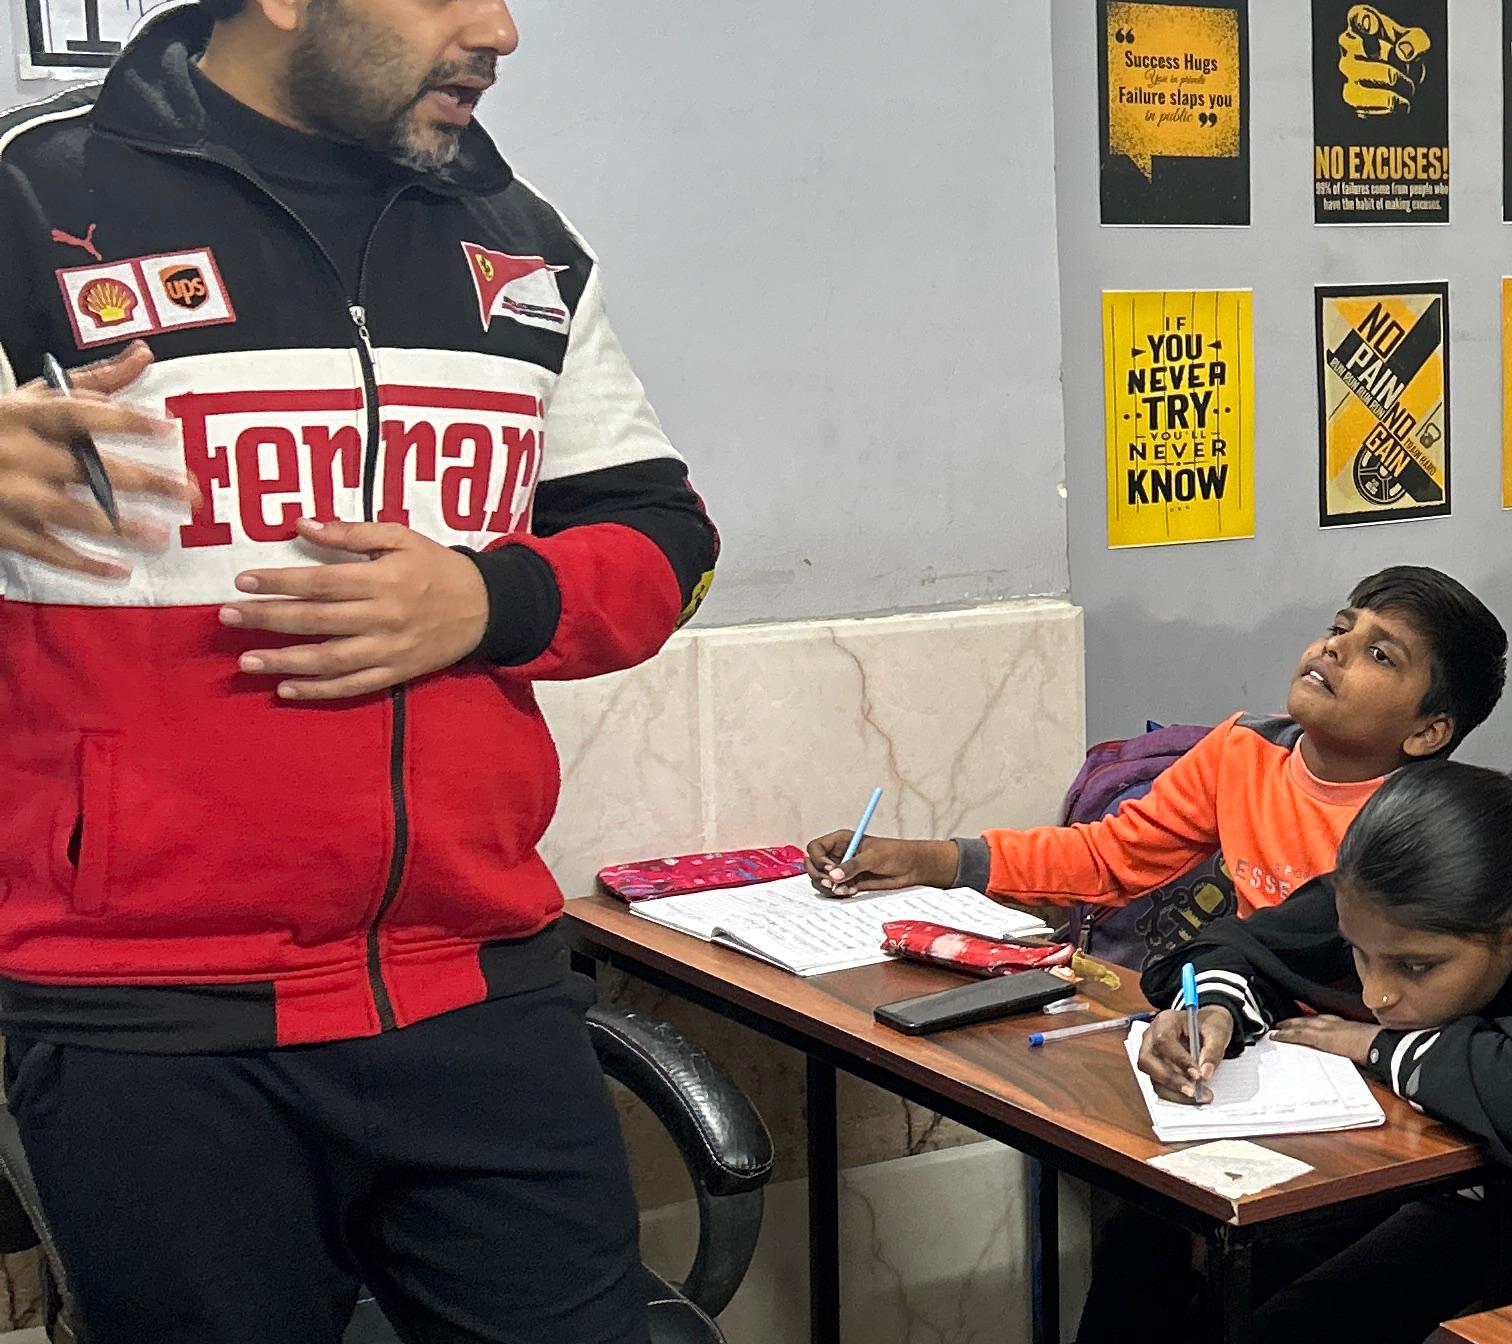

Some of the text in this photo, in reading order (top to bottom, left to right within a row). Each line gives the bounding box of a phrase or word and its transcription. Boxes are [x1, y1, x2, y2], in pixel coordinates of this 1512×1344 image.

[1125, 50, 1218, 72] Success Hugs
[1119, 86, 1232, 109] Failure slaps you
[1145, 108, 1193, 127] in public
[1315, 145, 1448, 180] NO EXCUSES!
[1323, 197, 1340, 210] have
[1341, 197, 1354, 210] the
[1355, 197, 1375, 210] habit
[1375, 197, 1384, 210] of
[1384, 197, 1412, 213] making
[1332, 181, 1340, 195] of
[1341, 181, 1369, 195] failures
[1370, 184, 1390, 195] come
[1391, 182, 1408, 195] from
[1409, 182, 1433, 198] people
[1434, 182, 1449, 195] who
[166, 277, 206, 304] ups
[1165, 316, 1187, 331] IF
[1357, 302, 1405, 359] NO
[1147, 333, 1203, 364] YOU
[1128, 361, 1226, 394] NEVER
[1330, 357, 1386, 419] RUN RUN RUN RUN
[1346, 342, 1404, 409] PAIN
[1142, 391, 1213, 431] TRY
[1382, 407, 1416, 439] NO
[1129, 439, 1227, 461] NEVER
[1151, 431, 1206, 441] YOU'LL
[1365, 425, 1411, 477] GAIN
[1404, 438, 1436, 476] TRAIN HARD
[1128, 464, 1229, 505] KNOW
